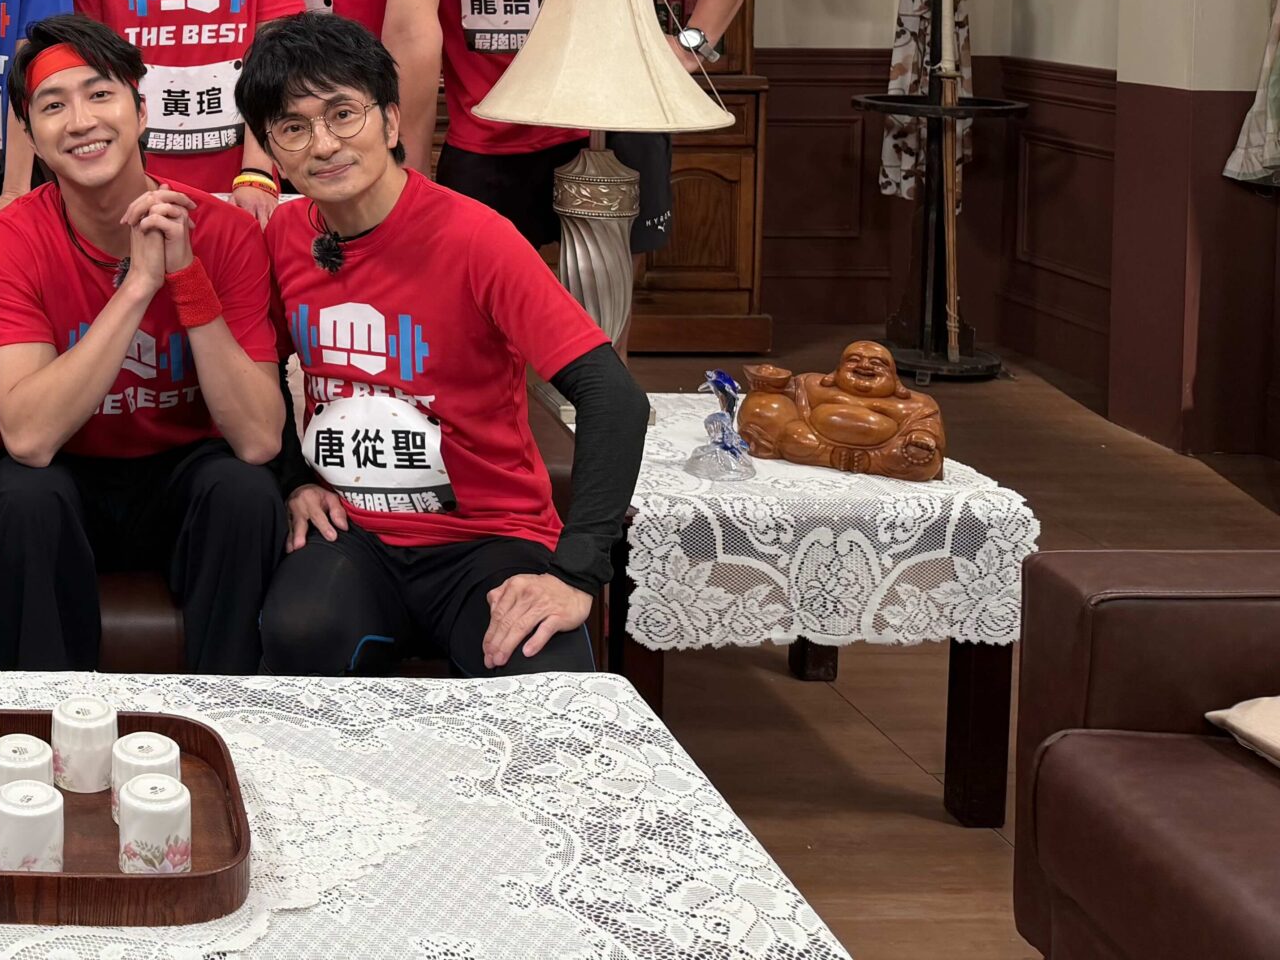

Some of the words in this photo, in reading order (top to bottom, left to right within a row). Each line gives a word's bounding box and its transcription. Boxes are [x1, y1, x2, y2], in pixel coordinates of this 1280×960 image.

[124, 25, 176, 47] THE
[182, 23, 248, 45] BEST
[474, 32, 528, 51] 最強明
[161, 86, 223, 117] 黃瑄
[146, 128, 237, 151] 最強明星隊
[306, 374, 345, 402] HE
[314, 427, 432, 470] 唐從聖
[340, 490, 443, 514] 強明星隊
